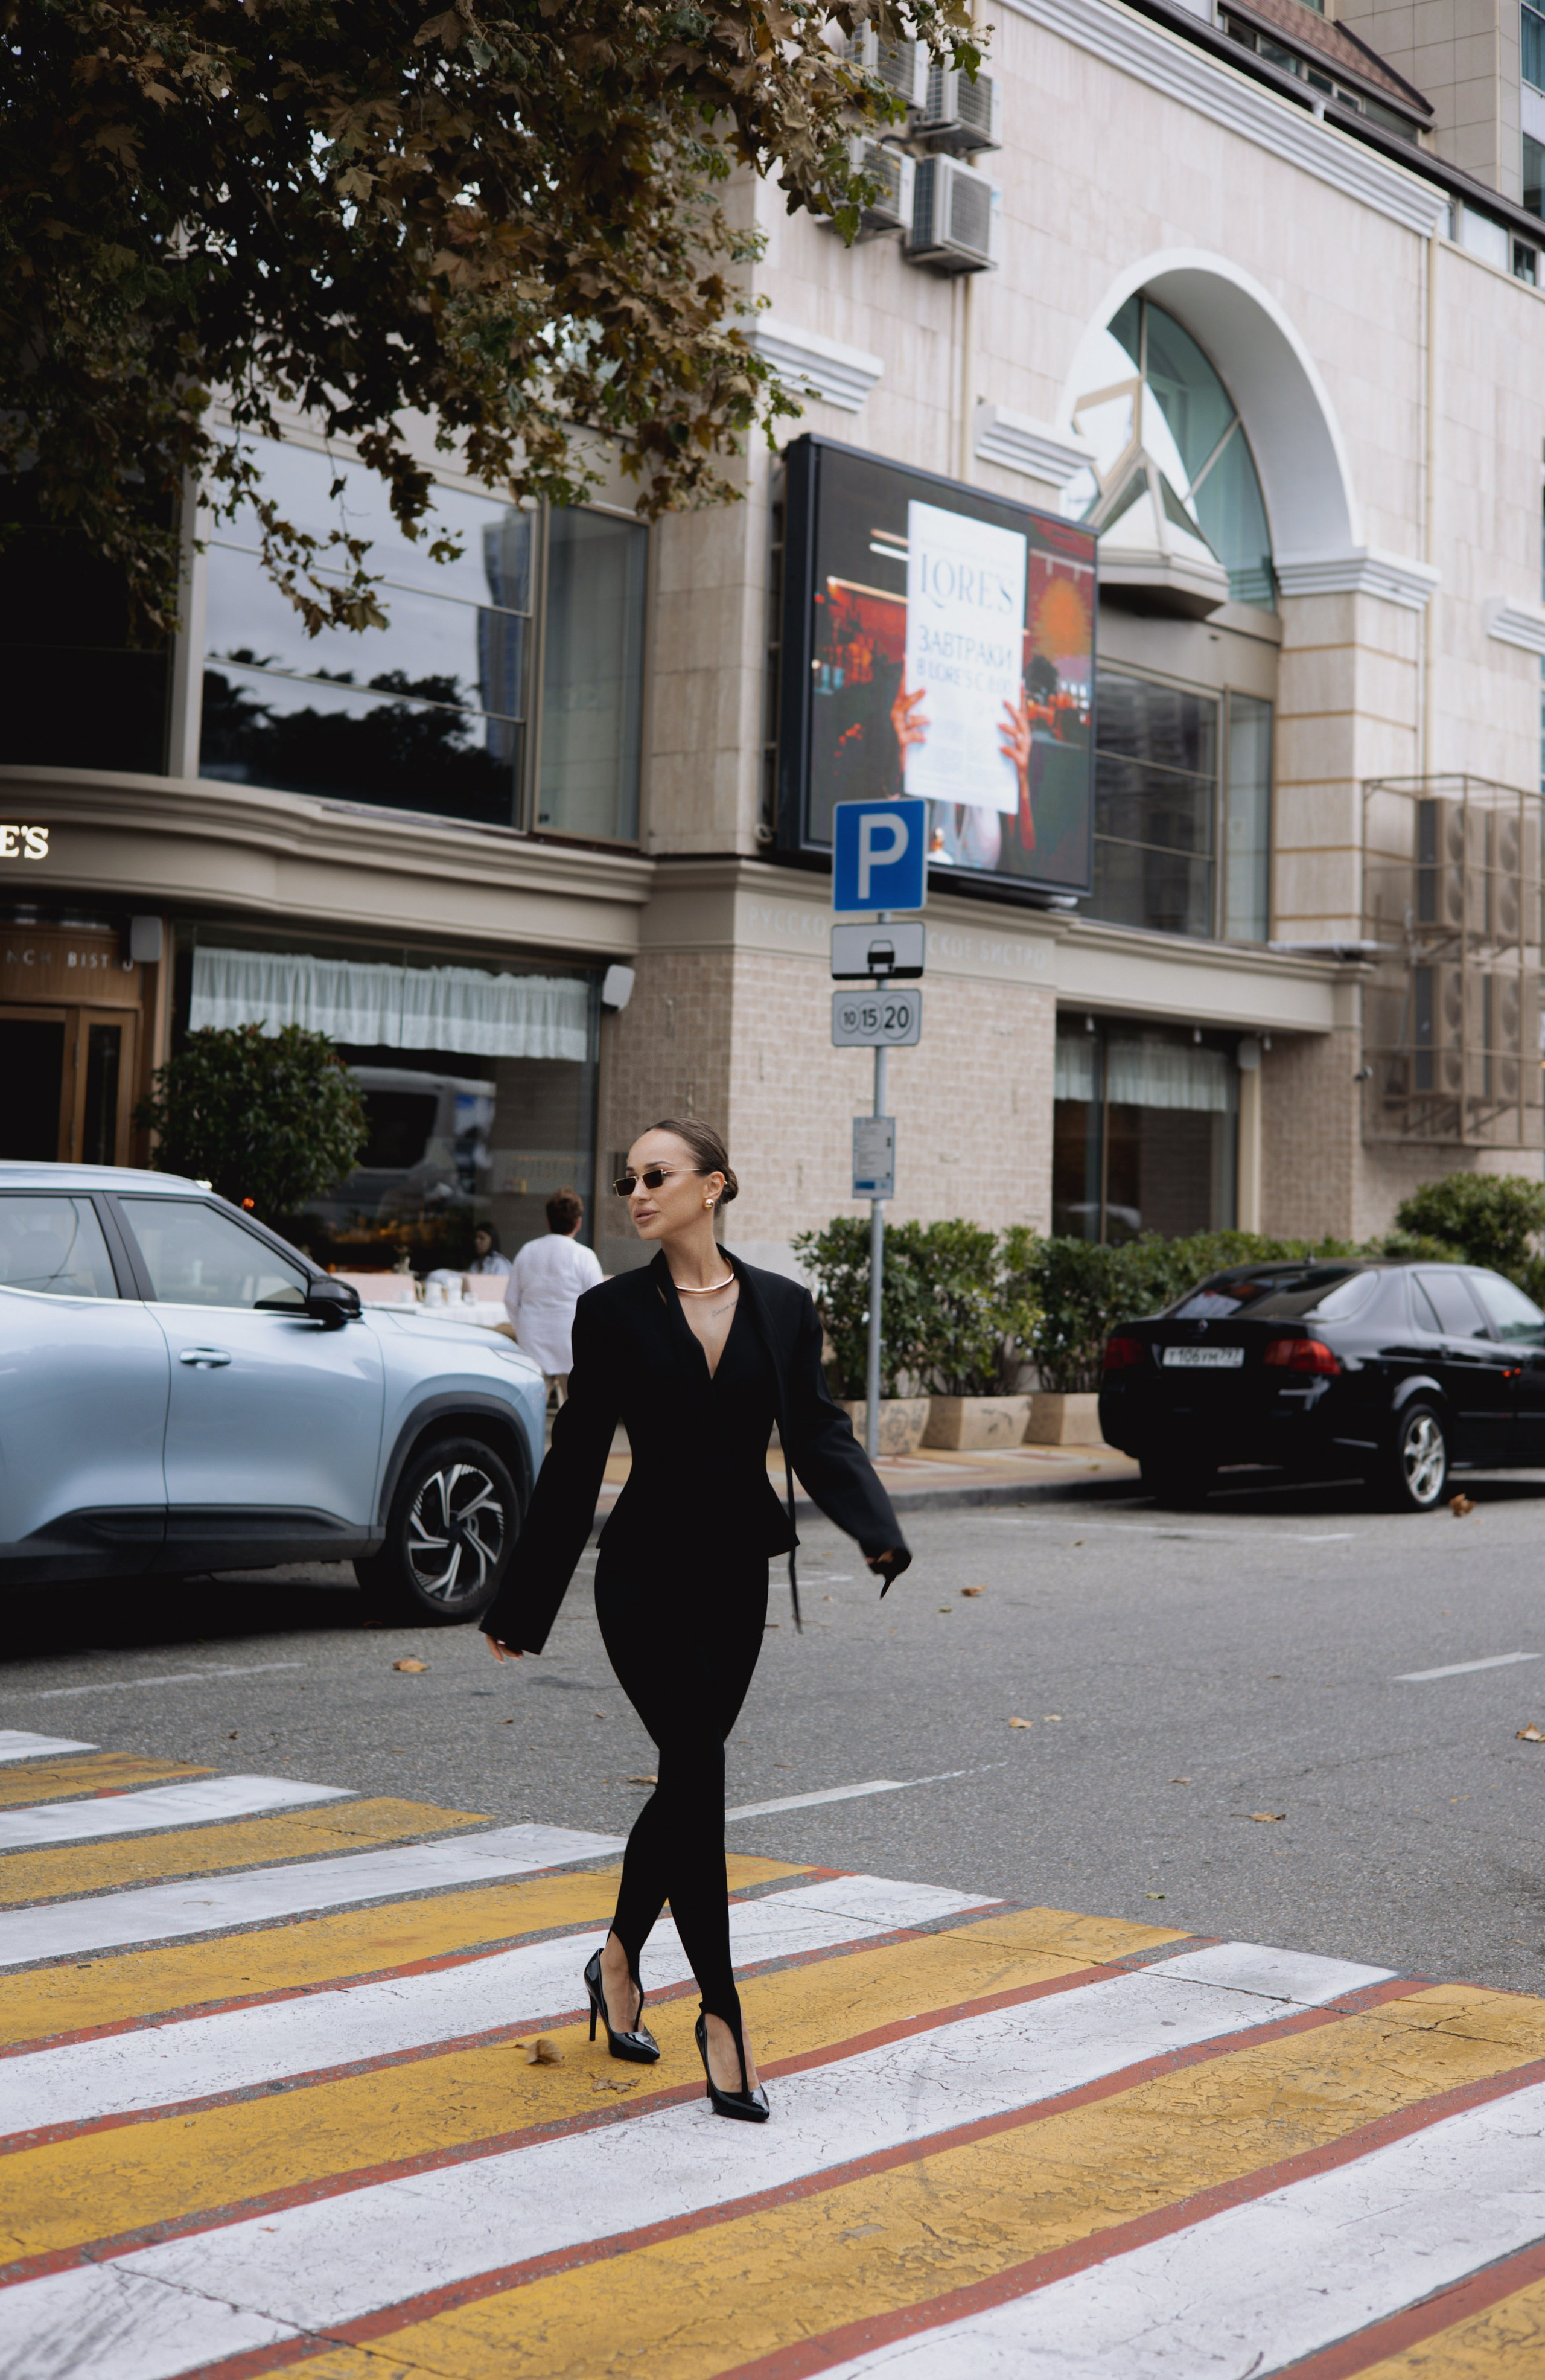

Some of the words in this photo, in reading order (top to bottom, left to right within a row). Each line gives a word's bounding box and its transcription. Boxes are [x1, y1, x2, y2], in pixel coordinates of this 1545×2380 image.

[918, 624, 1013, 671] ЗАВТРАКИ
[858, 813, 909, 899] P
[67, 951, 134, 972] BISTO
[844, 1011, 856, 1026] 10
[862, 1008, 878, 1027] 15
[884, 1005, 910, 1029] 20
